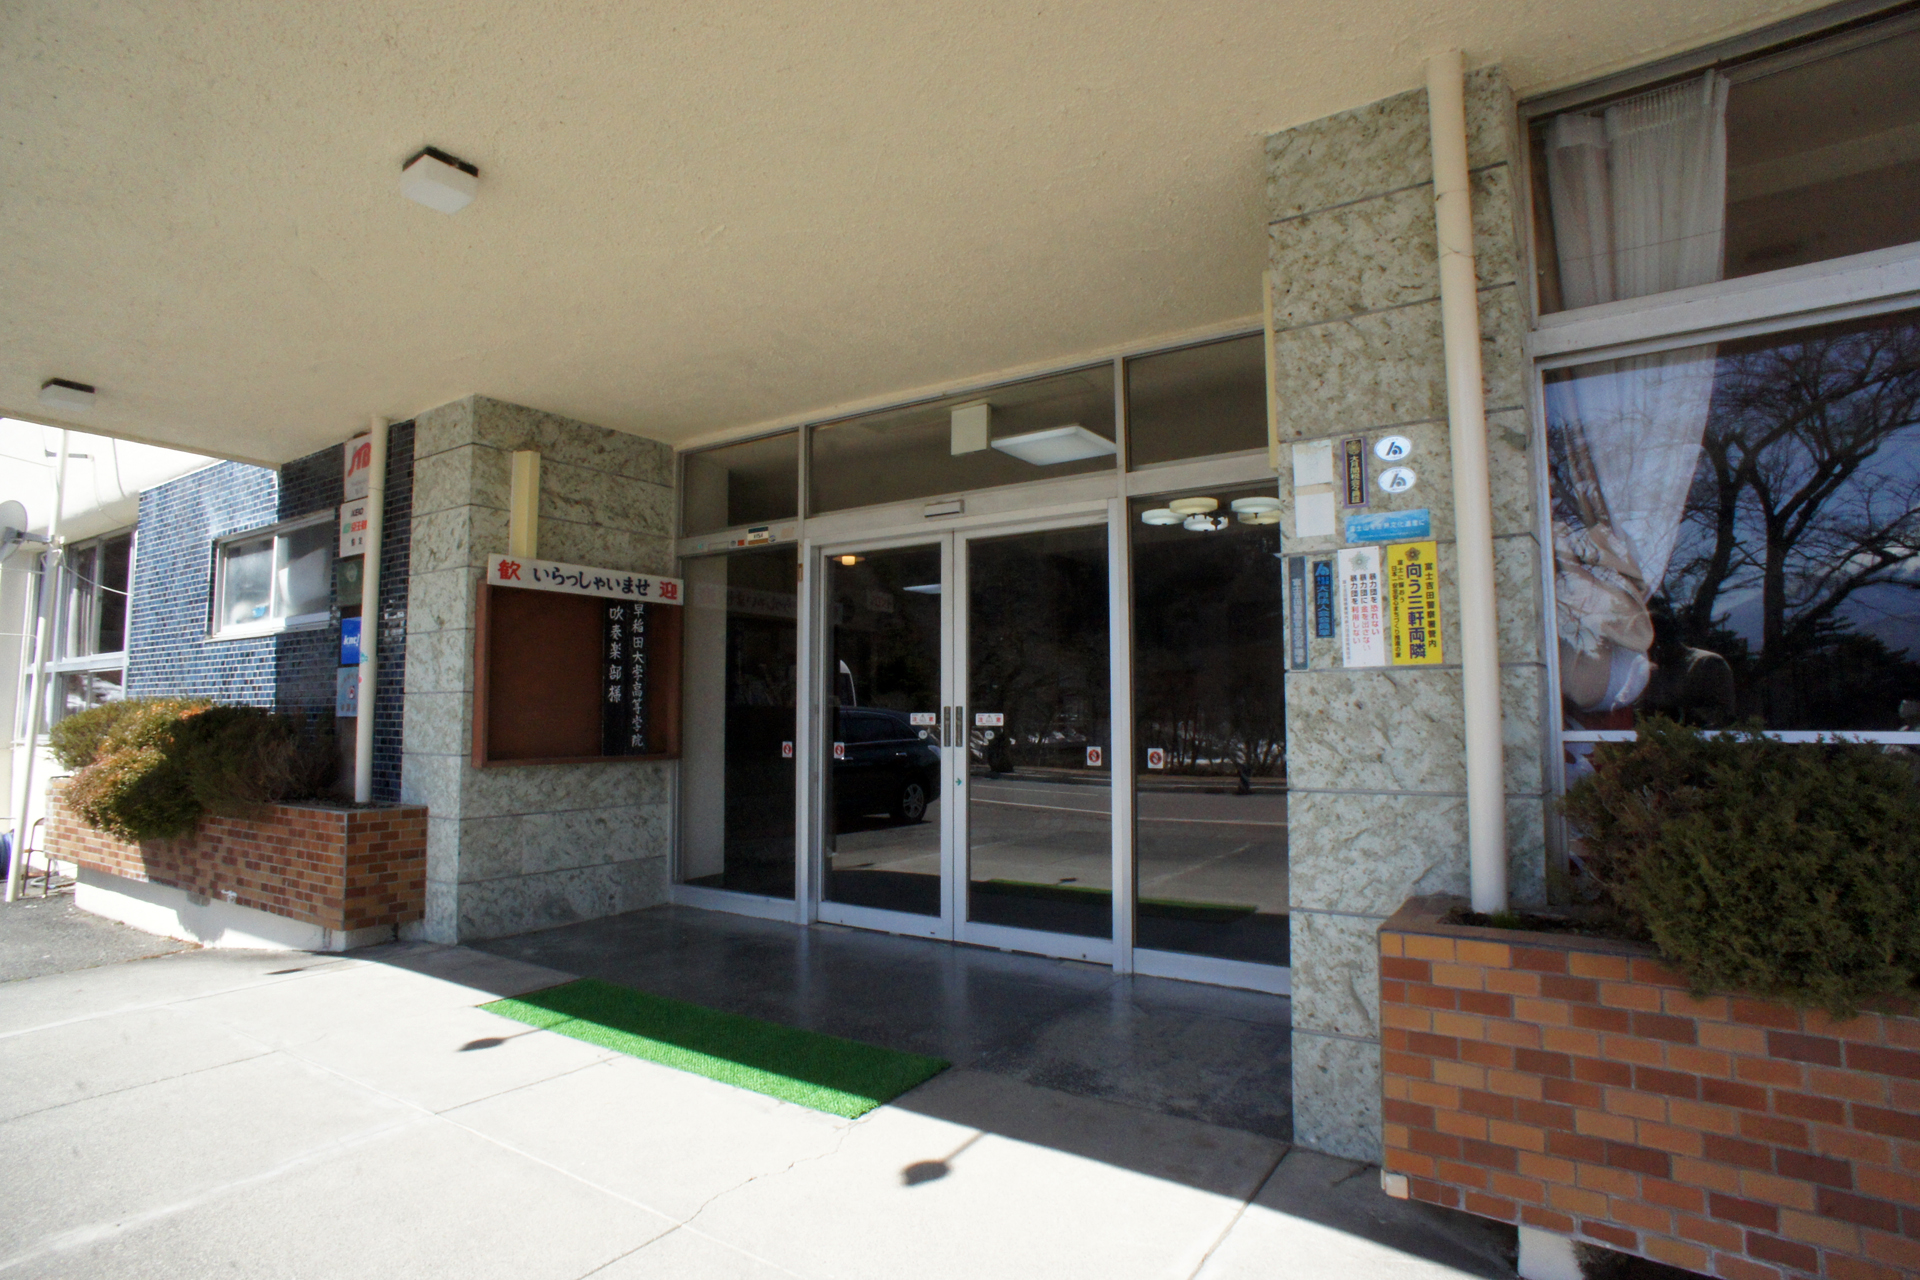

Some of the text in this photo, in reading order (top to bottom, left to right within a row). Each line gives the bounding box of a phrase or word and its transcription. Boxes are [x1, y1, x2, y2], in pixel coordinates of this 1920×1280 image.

[347, 442, 371, 478] JTB
[497, 559, 678, 600] 歓 いらっしゃいませ 迎
[1350, 575, 1361, 644] 暴力団を利用しない
[1360, 574, 1371, 651] 暴力団に金を出さない
[1369, 573, 1379, 635] 暴力団を恐れない
[1406, 563, 1427, 659] 向う三軒両隣
[607, 605, 624, 704] 吹奏楽部様
[632, 602, 645, 747] 早稲田大学高等学院
